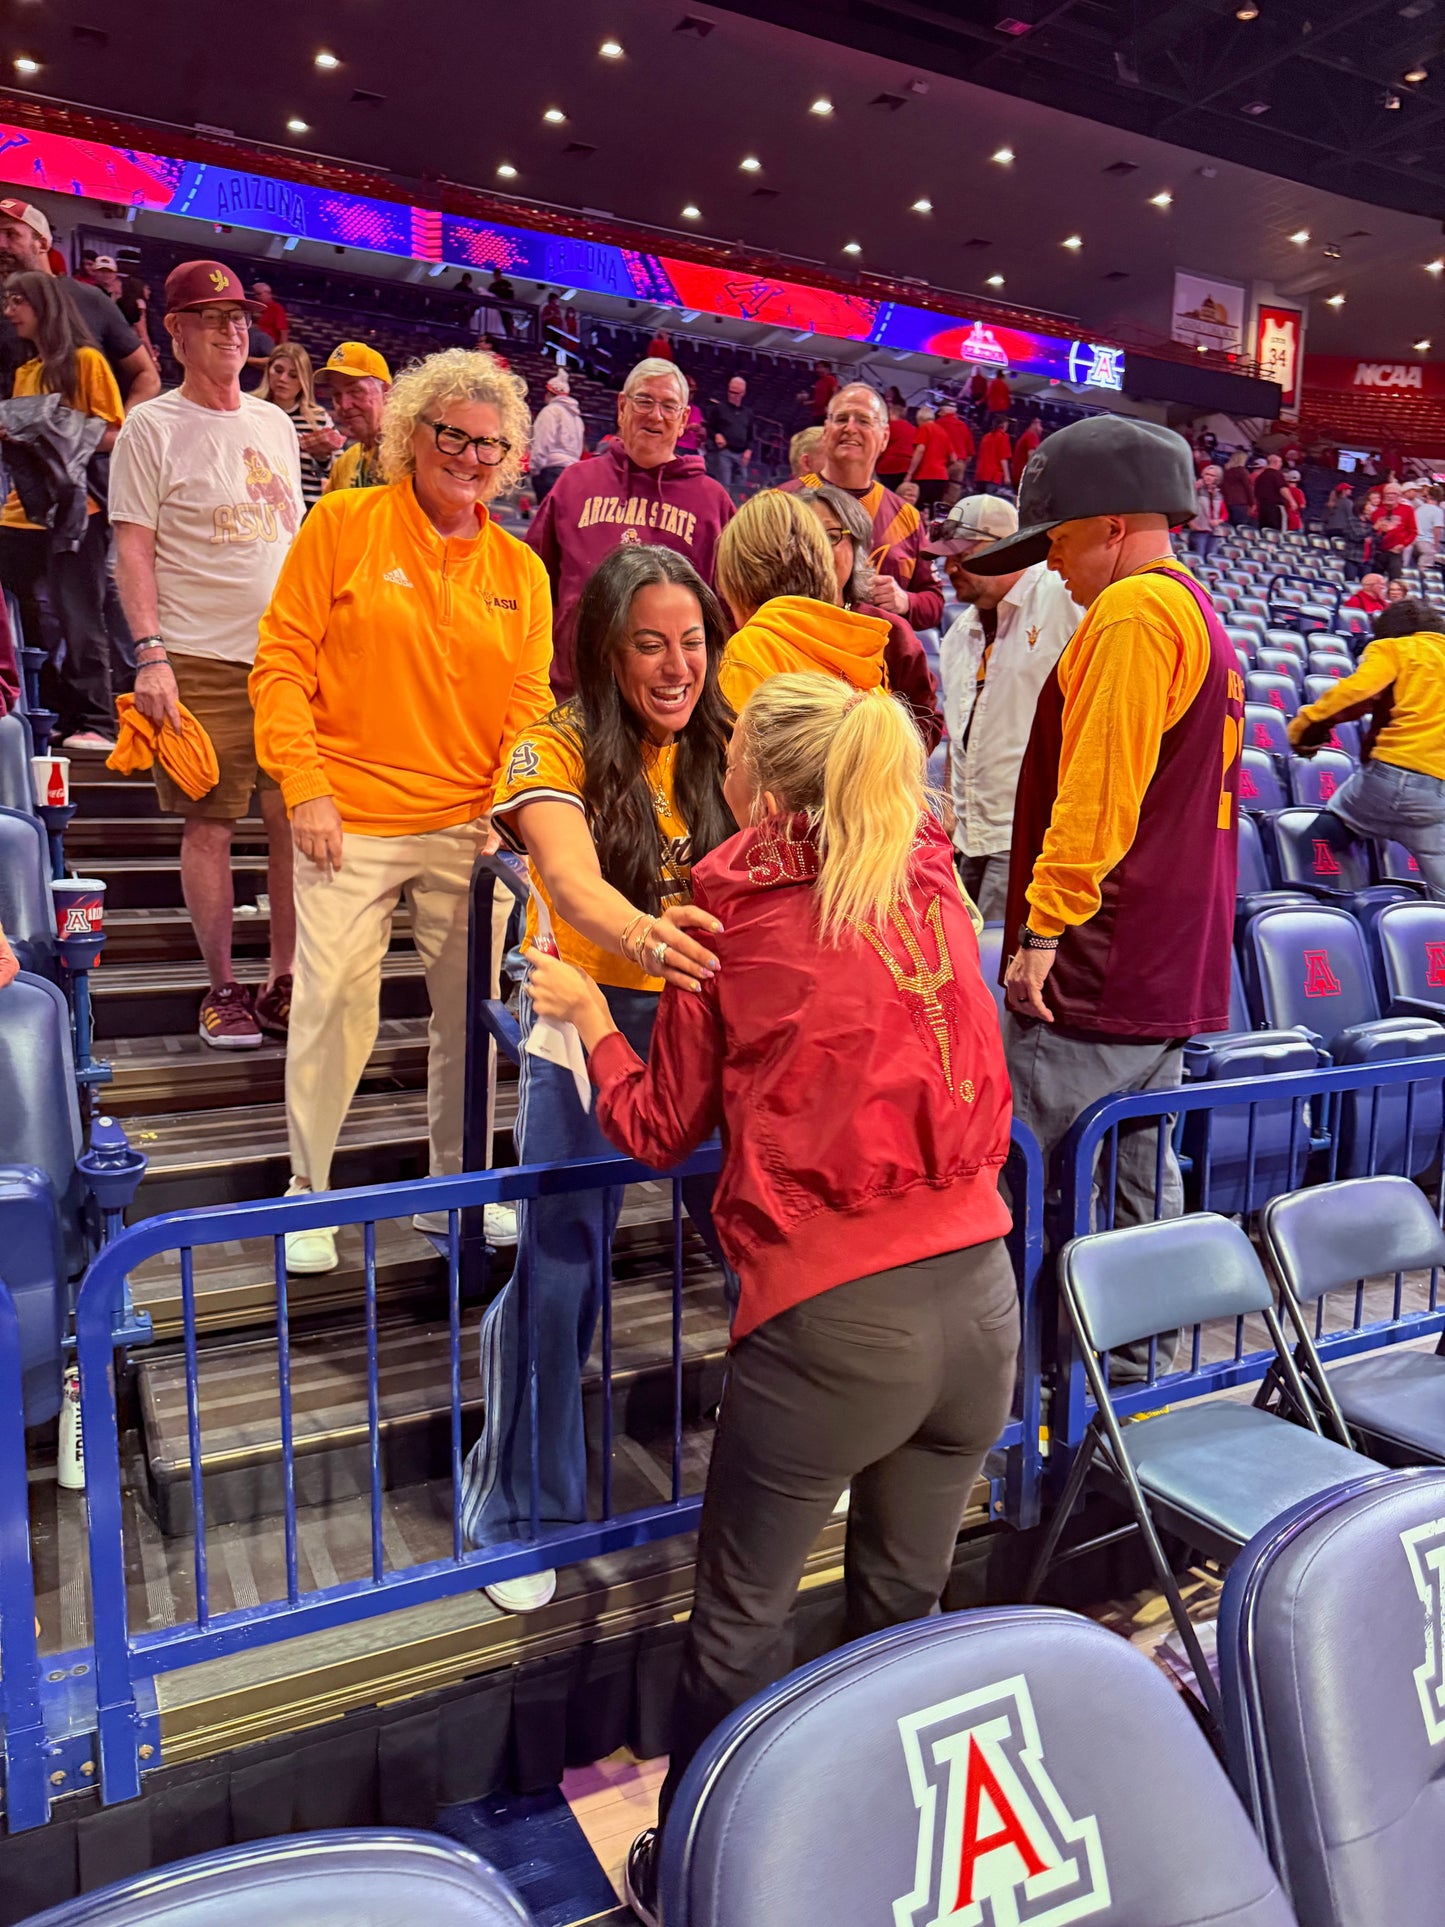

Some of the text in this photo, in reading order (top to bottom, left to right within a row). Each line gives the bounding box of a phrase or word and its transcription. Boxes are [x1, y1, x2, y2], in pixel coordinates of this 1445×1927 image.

[218, 177, 306, 236] ARIZONA
[1086, 344, 1124, 391] A
[1269, 348, 1286, 367] 34
[1353, 363, 1422, 389] NCAA
[210, 503, 277, 543] ASU
[578, 496, 697, 546] ARIZONA STATE
[493, 598, 517, 611] ASU
[1312, 839, 1342, 874] A
[65, 909, 92, 932] A
[1303, 949, 1342, 998] A
[892, 1673, 1112, 1927] A
